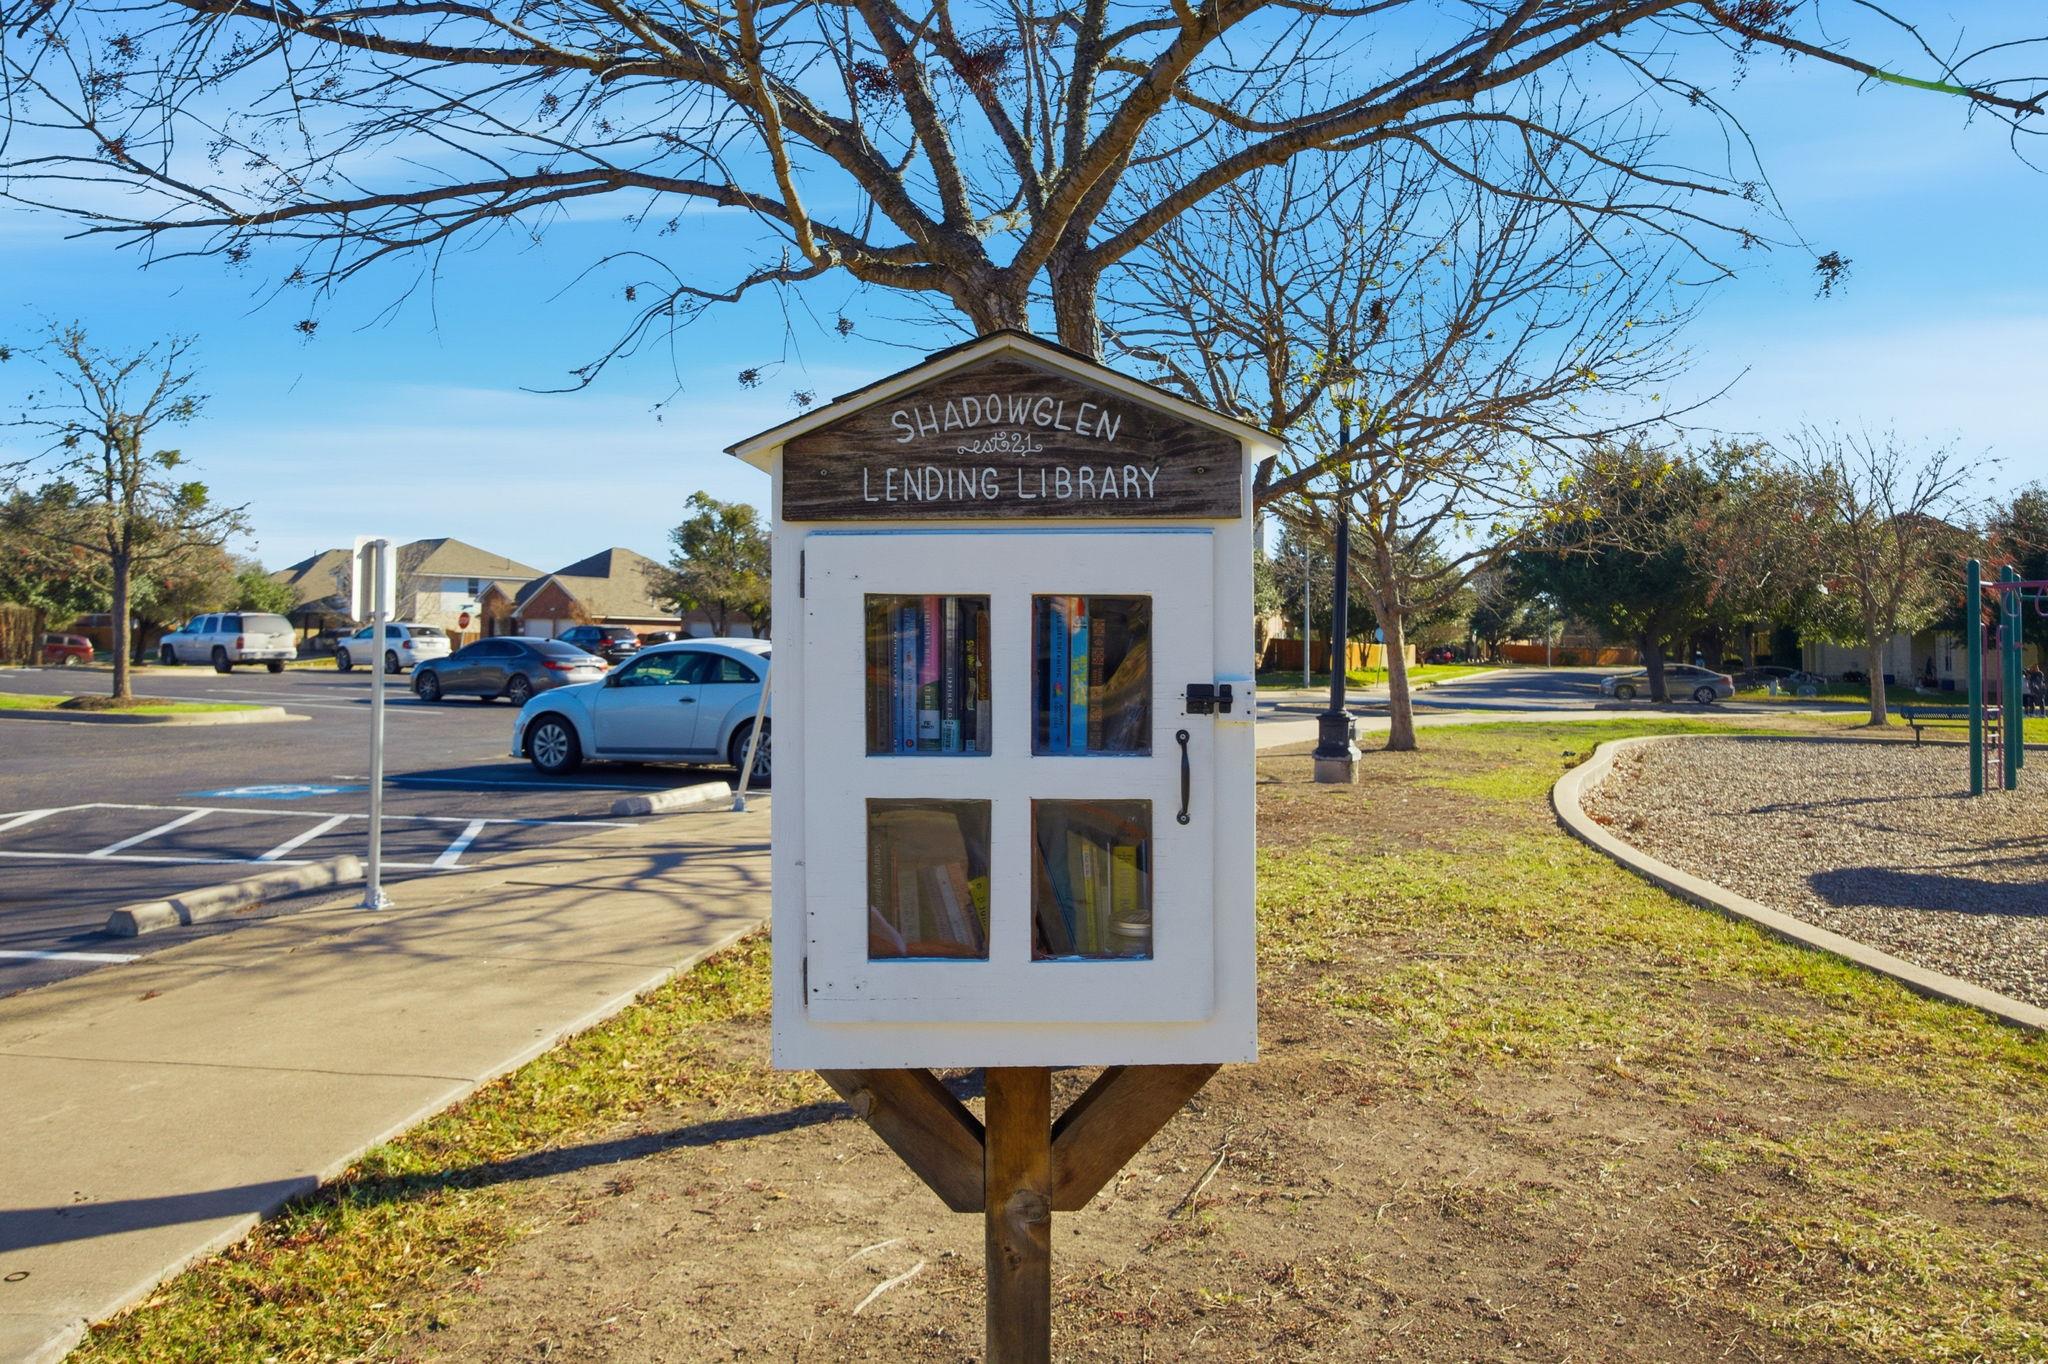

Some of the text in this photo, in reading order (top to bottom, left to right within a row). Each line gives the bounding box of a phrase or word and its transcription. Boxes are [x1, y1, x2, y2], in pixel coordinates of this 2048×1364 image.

[891, 393, 1121, 443] SHADOWGLEN
[863, 464, 1160, 502] LENDING LIBRARY
